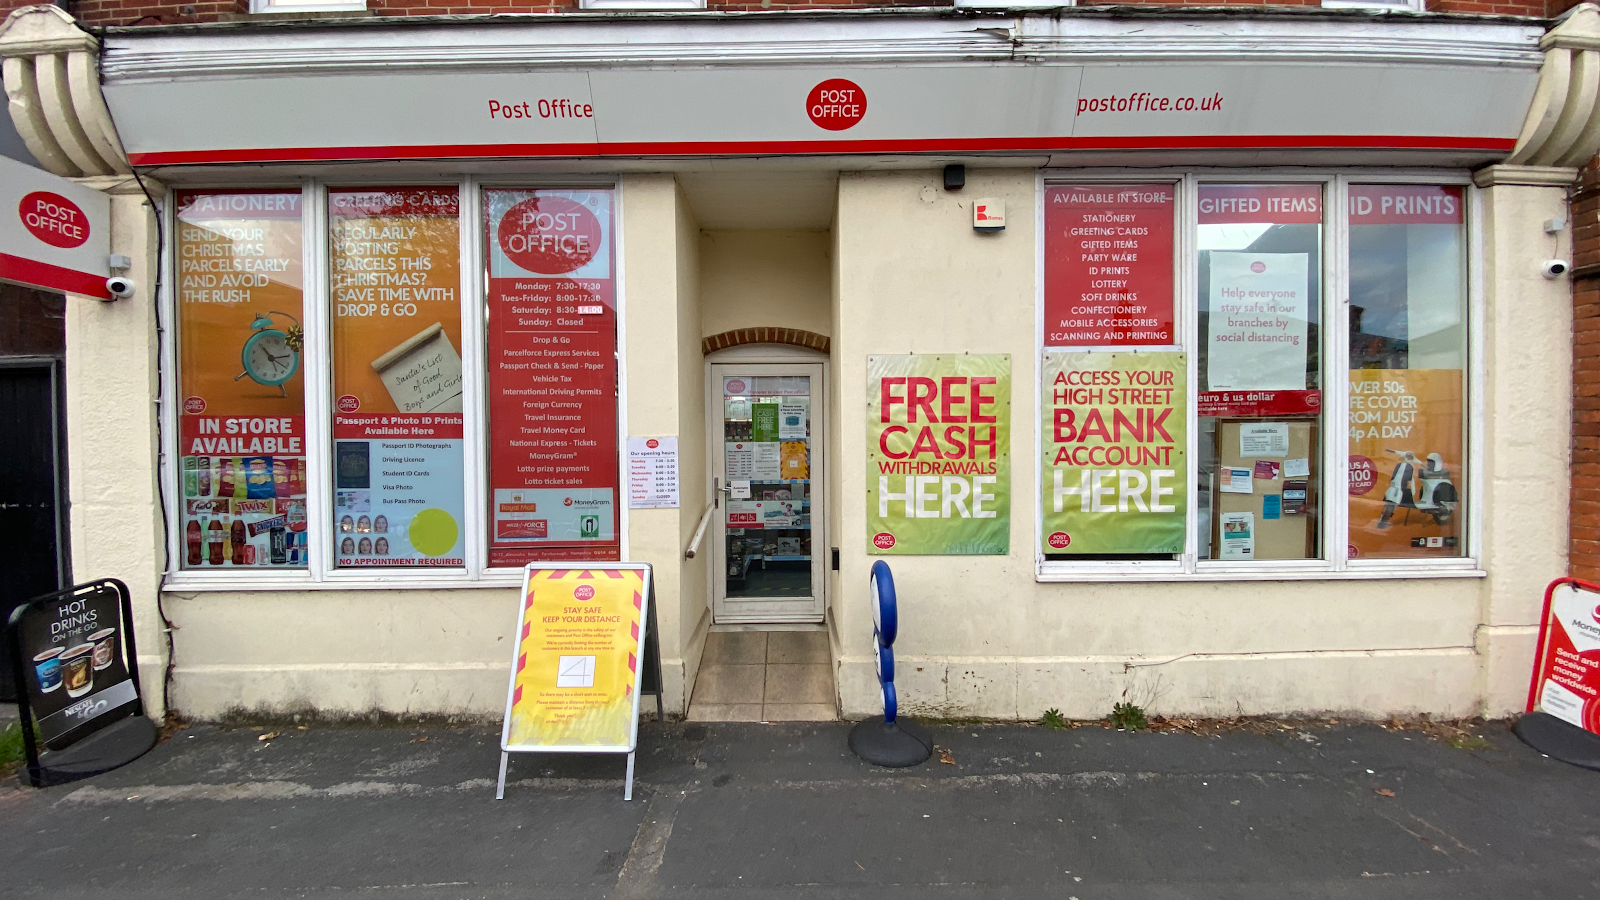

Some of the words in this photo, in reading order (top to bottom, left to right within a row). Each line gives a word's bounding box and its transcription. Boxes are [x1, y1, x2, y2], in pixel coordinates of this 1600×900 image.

[820, 89, 855, 103] POST
[488, 99, 532, 119] Post
[538, 98, 593, 118] Office
[1077, 92, 1223, 116] postoffice.co.uk
[812, 105, 860, 118] OFFICE
[182, 194, 299, 212] STATIONERY
[333, 194, 405, 208] GREETING
[409, 194, 459, 207] CARDS
[1053, 192, 1114, 204] AVAILABLE
[1117, 192, 1129, 203] IN
[1132, 191, 1166, 203] STORE
[36, 200, 77, 222] POST
[1199, 197, 1261, 214] GIFTED
[1267, 197, 1317, 213] ITEMS
[1350, 196, 1372, 215] ID
[1381, 195, 1455, 215] PRINTS
[522, 213, 581, 231] POST
[1083, 214, 1136, 222] STATIONERY
[26, 213, 82, 240] OFFICE
[336, 226, 416, 240] REGULARLY
[1070, 227, 1115, 235] GREETING
[1117, 227, 1148, 235] CARDS
[182, 228, 220, 242] SEND
[221, 228, 264, 241] YOUR
[182, 243, 265, 257] CHRISTMAS
[336, 242, 399, 255] POSTING
[508, 234, 589, 253] OFFICE
[1080, 240, 1111, 248] GIFTED
[1113, 240, 1138, 248] ITEMS
[336, 257, 396, 270] PARCELS
[399, 257, 432, 270] THIS
[1081, 253, 1109, 261] PARTY
[1111, 253, 1138, 261] WARE
[182, 259, 242, 272] PARCELS
[245, 259, 289, 272] EARLY
[1089, 267, 1099, 275] ID
[1101, 266, 1130, 275] PRINTS
[182, 274, 216, 287] AND
[219, 274, 269, 287] AVOID
[336, 272, 428, 286] CHRISTMAS?
[1091, 280, 1127, 288] LOTTERY
[515, 282, 552, 291] Monday:
[556, 282, 601, 290] 7:30-17:30
[182, 290, 210, 302] THE
[212, 290, 251, 302] RUSH
[336, 288, 374, 301] SAVE
[378, 288, 410, 300] TIME
[412, 287, 454, 300] WITH
[501, 294, 552, 303] Tues-Friday:
[556, 294, 601, 302] 8:00-17:30
[1081, 293, 1102, 301] SOFT
[1105, 292, 1138, 301] DRINKS
[1221, 288, 1245, 300] Help
[1248, 289, 1296, 301] everyone
[336, 303, 377, 317] DROP
[380, 303, 390, 316] &
[392, 303, 418, 317] GO
[512, 306, 552, 315] Saturday:
[1071, 306, 1147, 314] CONFECTIONERY
[1220, 303, 1241, 315] stay
[1244, 303, 1264, 313] safe
[1266, 303, 1276, 313] in
[1278, 305, 1296, 313] our
[518, 318, 552, 327] Sunday:
[556, 318, 584, 326] Closed
[1060, 319, 1094, 327] MOBILE
[1096, 318, 1158, 327] ACCESSORIES
[1227, 317, 1273, 328] branches
[1275, 317, 1289, 330] by
[1050, 332, 1101, 341] SCANNING
[1103, 331, 1124, 339] AND
[1126, 331, 1168, 339] PRINTING
[1216, 332, 1244, 343] social
[1247, 332, 1300, 345] distancing
[543, 350, 570, 358] Express
[395, 363, 427, 386] Santa's
[426, 353, 444, 368] List
[413, 379, 422, 394] of
[422, 367, 444, 385] Good
[532, 375, 559, 383] Vehicle
[560, 375, 573, 383] Tax
[1053, 371, 1121, 386] ACCESS
[1126, 371, 1174, 385] YOUR
[502, 388, 548, 396] International
[549, 388, 575, 397] Driving
[576, 388, 602, 396] Permits
[1053, 388, 1101, 405] HIGH
[1107, 388, 1174, 405] STREET
[522, 401, 550, 410] Foreign
[551, 401, 583, 410] Currency
[879, 376, 997, 424] FREE
[1367, 396, 1418, 409] COVER
[336, 416, 379, 426] Passport
[381, 416, 389, 425] &
[391, 416, 420, 425] Photo
[422, 416, 433, 425] ID
[434, 416, 463, 425] Prints
[1384, 411, 1418, 424] JUST
[199, 418, 220, 434] IN
[225, 417, 292, 434] STORE
[364, 427, 407, 436] Available
[411, 427, 435, 435] Here
[543, 427, 568, 435] Money
[1053, 407, 1175, 443] BANK
[190, 437, 301, 454] AVAILABLE
[879, 425, 997, 460] CASH
[1053, 446, 1174, 466] ACCOUNT
[536, 465, 555, 474] prize
[555, 465, 590, 474] payments
[878, 461, 997, 475] WITHDRAWALS
[566, 477, 583, 485] sales
[878, 476, 997, 518] HERE
[1053, 469, 1176, 513] HERE
[417, 557, 463, 565] REQUIRED
[58, 598, 87, 618] HOT
[563, 606, 583, 614] STAY
[584, 606, 602, 614] SAFE
[51, 609, 98, 635] DRINKS
[584, 615, 621, 623] DISTANCE
[52, 632, 66, 643] ON
[67, 627, 82, 638] THE
[83, 621, 98, 632] GO
[1556, 647, 1580, 662] Send
[1580, 656, 1599, 669] and
[559, 656, 591, 686] 4
[1554, 656, 1587, 674] receive
[1553, 664, 1584, 683] money
[1551, 672, 1598, 697] worldwide
